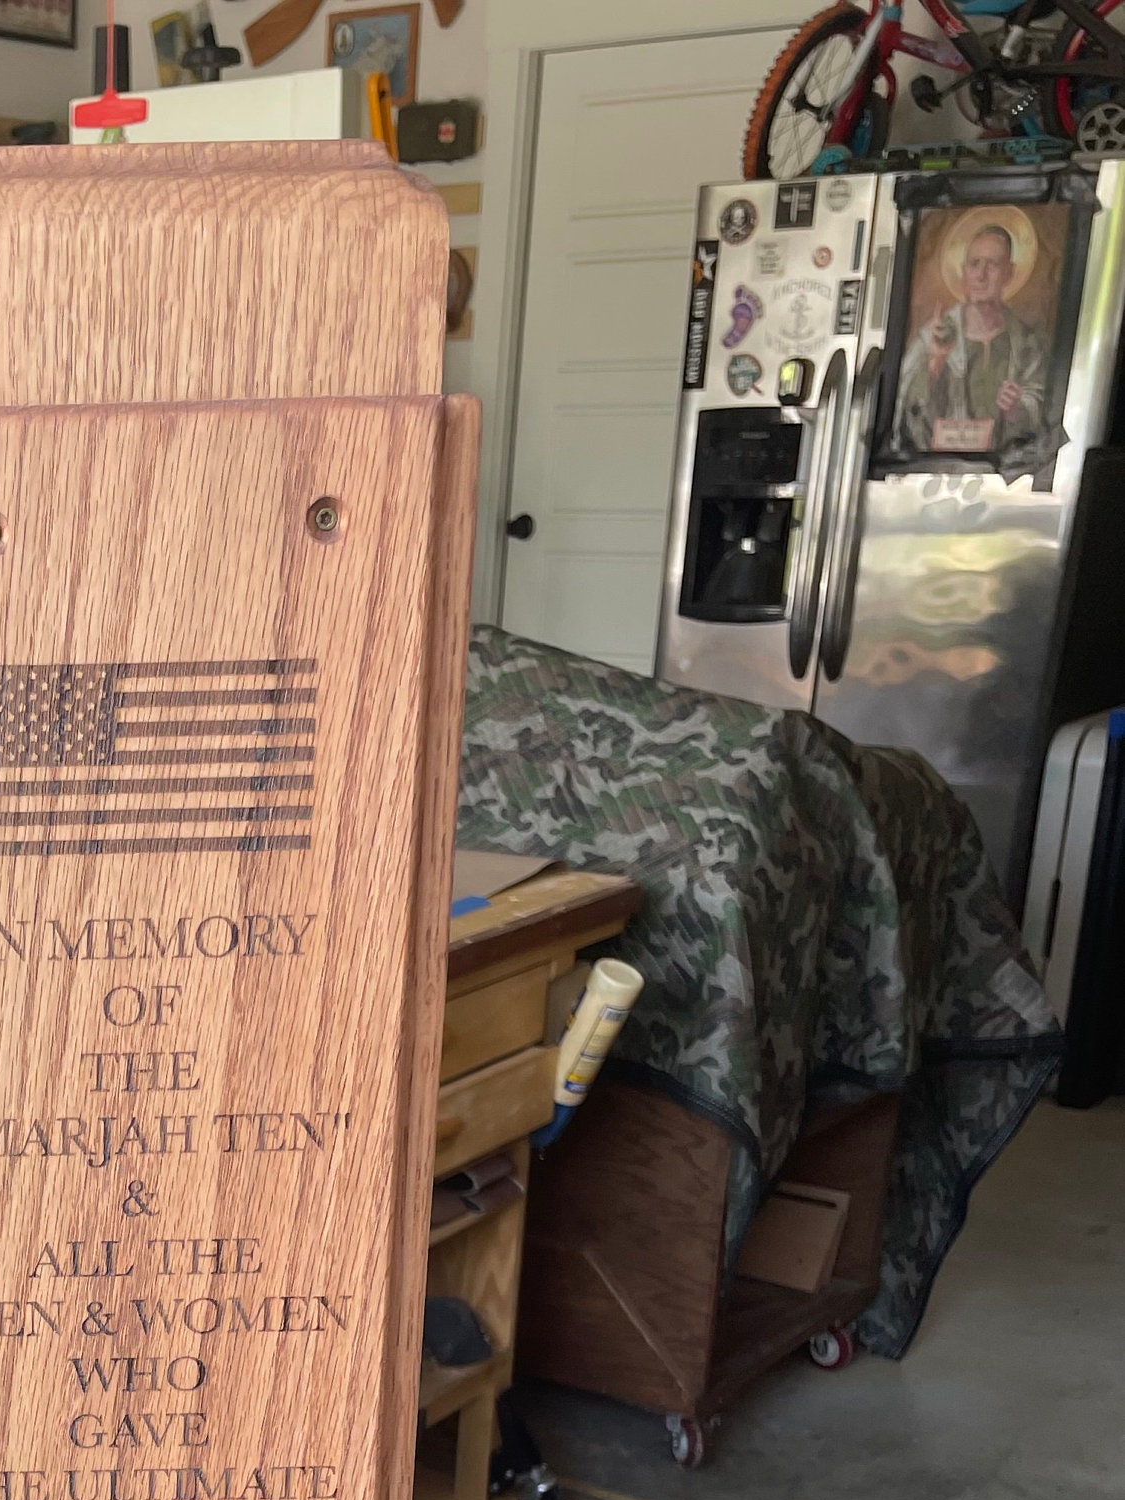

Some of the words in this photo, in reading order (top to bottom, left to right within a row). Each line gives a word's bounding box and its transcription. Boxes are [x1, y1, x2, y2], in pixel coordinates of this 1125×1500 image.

[47, 914, 318, 961] MEMORY
[103, 985, 183, 1028] OF
[80, 1050, 201, 1093] THE
[213, 1112, 352, 1154] TEN"
[121, 1179, 161, 1218] &
[28, 1240, 135, 1279] ALL
[147, 1237, 264, 1276] THE
[81, 1301, 119, 1336] &
[130, 1294, 353, 1335] WOMEN
[71, 1355, 207, 1394] WHO
[68, 1412, 211, 1449] GAVE
